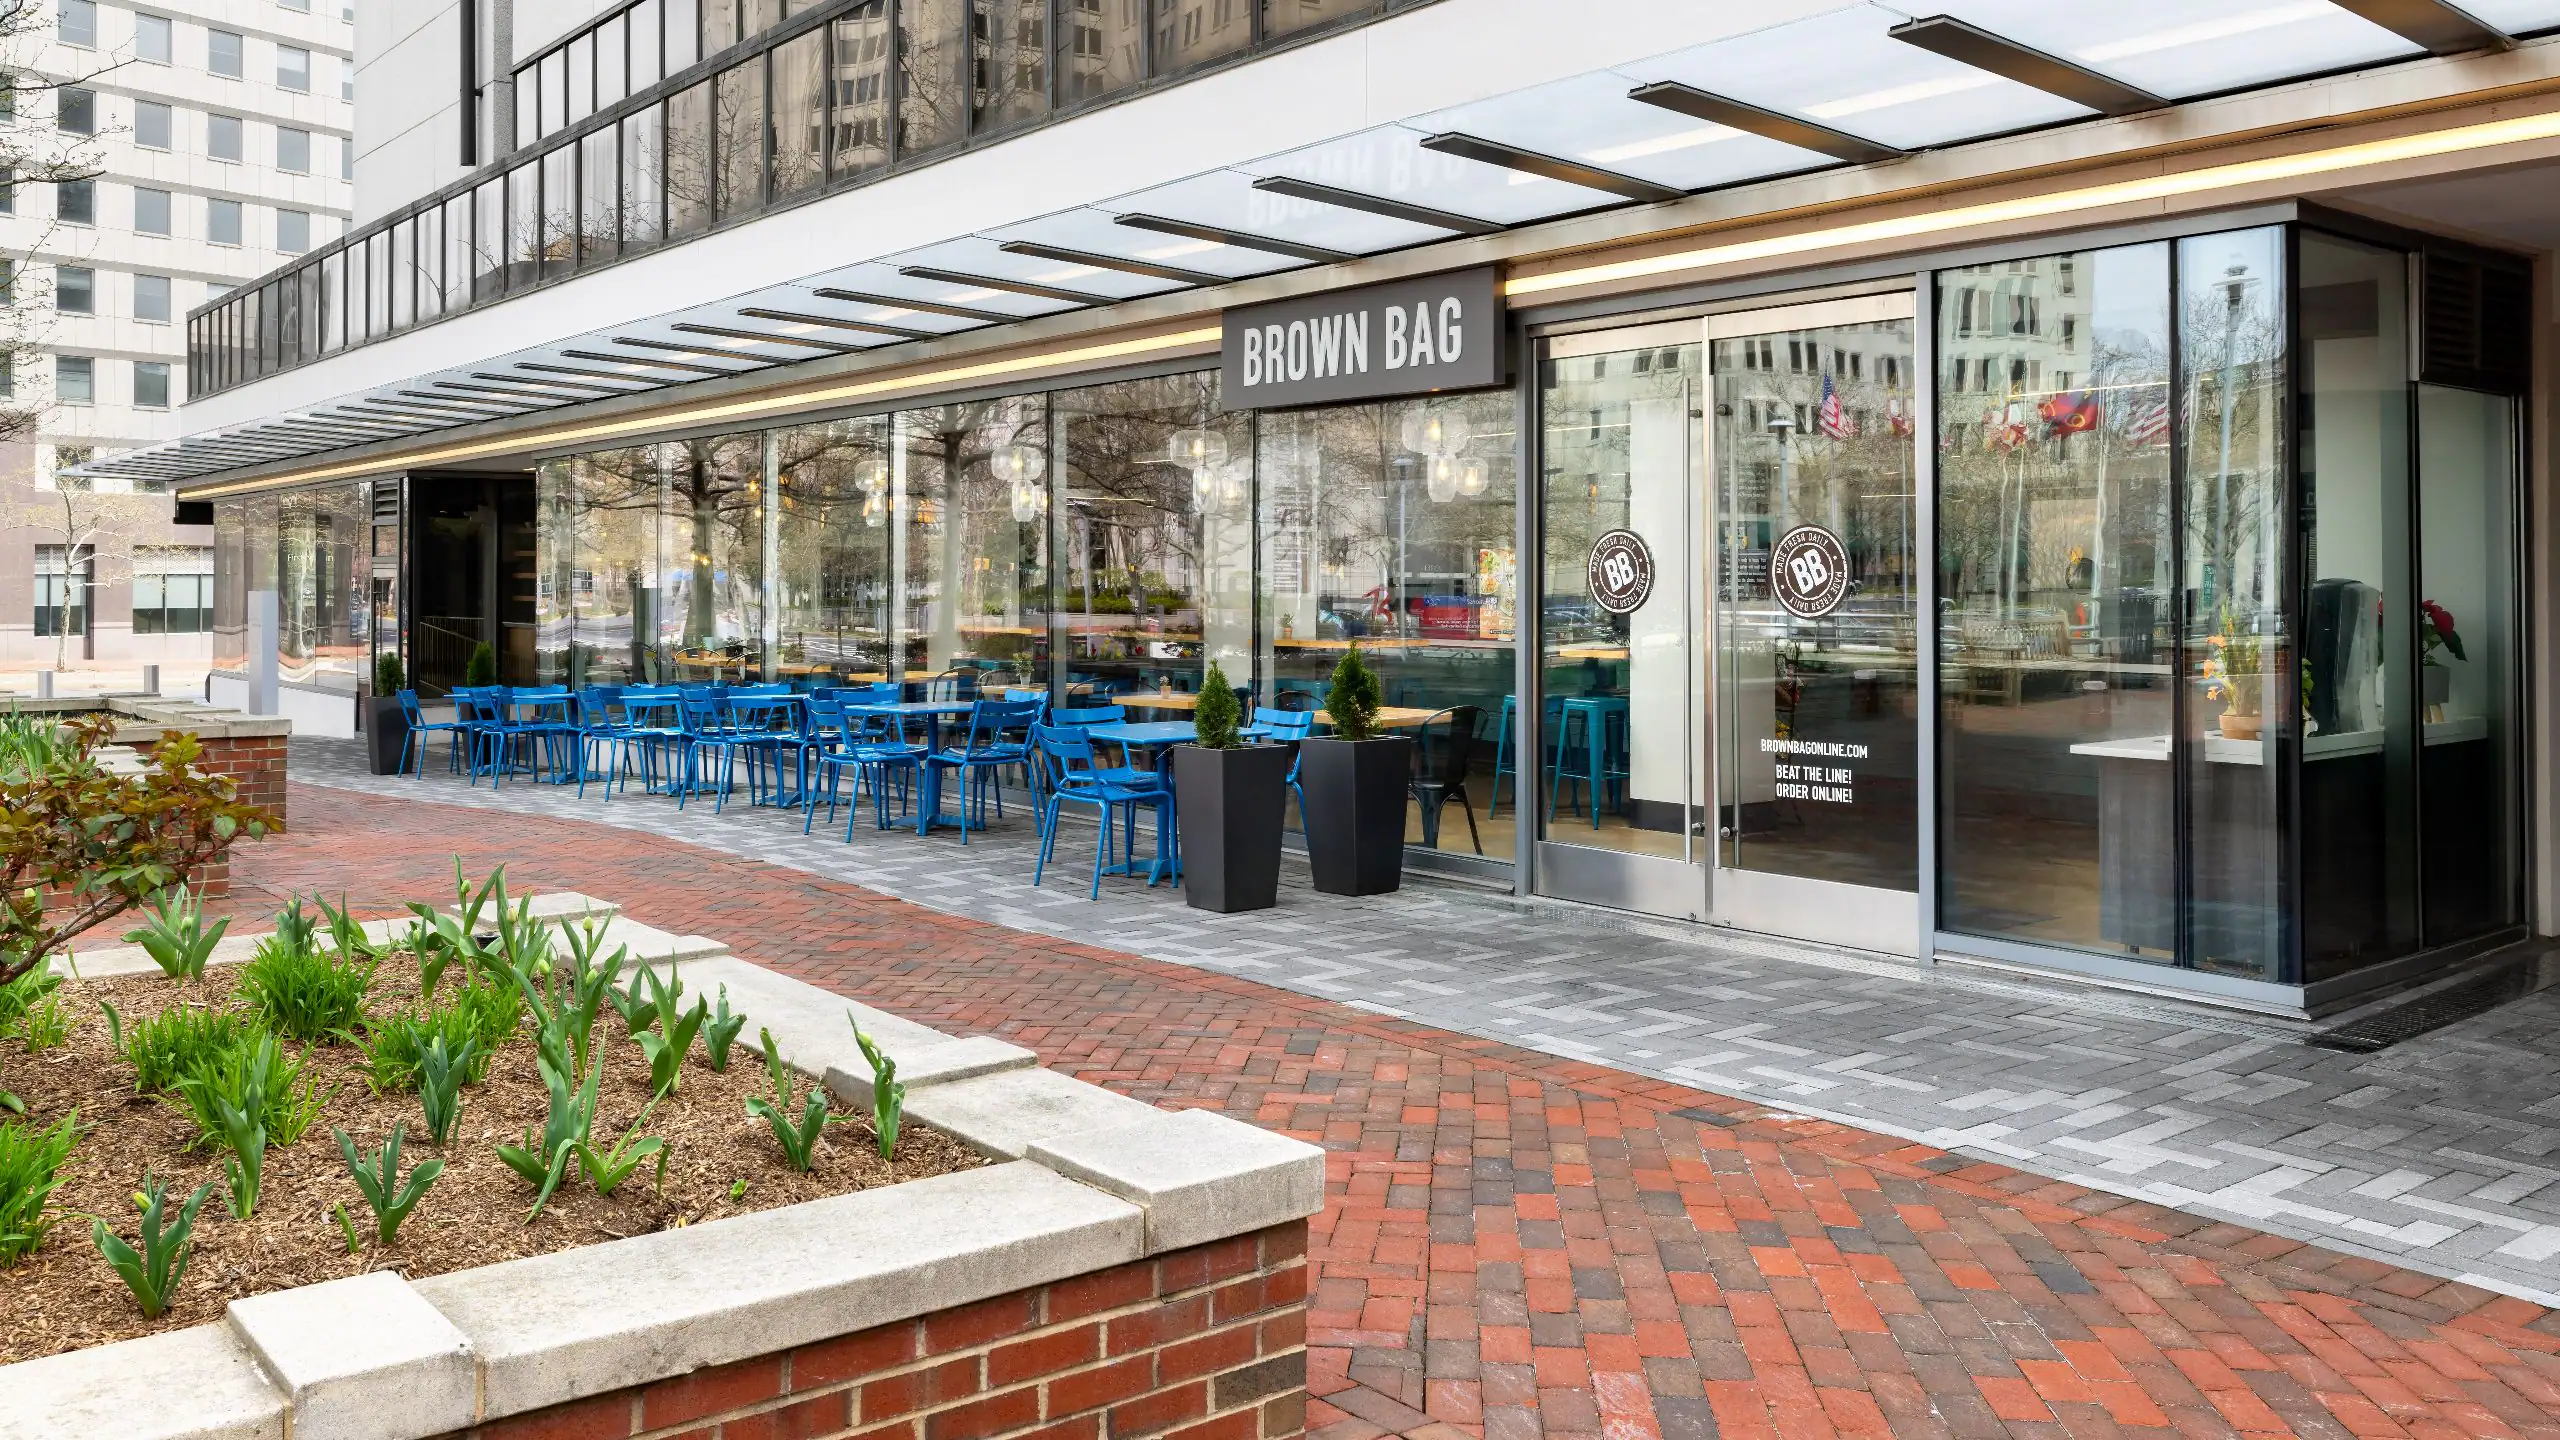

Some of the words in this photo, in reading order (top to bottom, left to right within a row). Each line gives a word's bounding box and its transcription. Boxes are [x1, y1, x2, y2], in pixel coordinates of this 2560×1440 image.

[1243, 311, 1369, 387] BROWN
[1385, 296, 1462, 370] BAG
[1776, 552, 1787, 574] MADE
[1784, 534, 1805, 551] FRESH
[1808, 532, 1829, 547] DAILY
[1604, 552, 1634, 592] BB
[1790, 548, 1828, 595] BB
[1830, 571, 1843, 595] MADE
[1788, 596, 1809, 612] DAILY
[1811, 593, 1833, 609] FRESH
[1761, 739, 1868, 758] BROWNBAGONLINE.COM
[1775, 764, 1801, 780] BEAT
[1803, 766, 1823, 782] THE
[1825, 767, 1852, 784] LINE!
[1776, 783, 1809, 800] ORDER
[1811, 785, 1853, 804] ONLINE!
